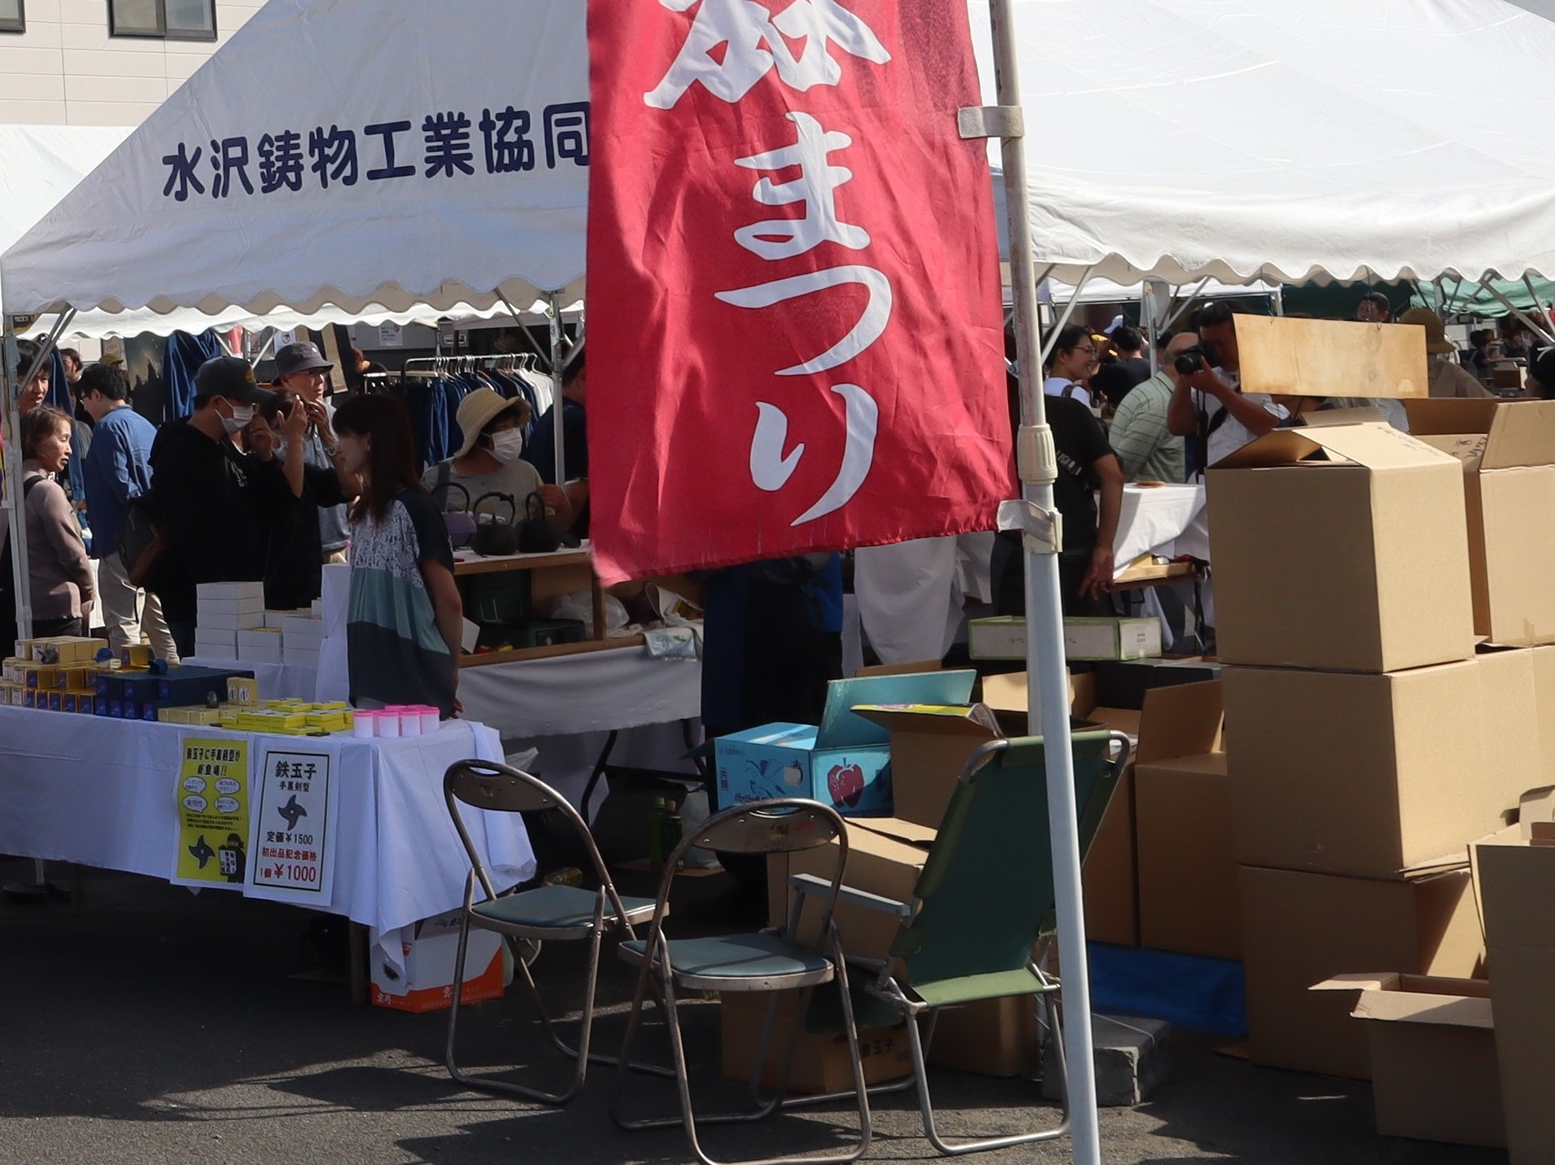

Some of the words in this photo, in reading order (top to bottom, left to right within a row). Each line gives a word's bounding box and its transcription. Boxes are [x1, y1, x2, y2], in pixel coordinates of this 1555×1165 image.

[161, 101, 591, 202] 水沢鋳物工業協同
[275, 760, 317, 780] 鉄玉子
